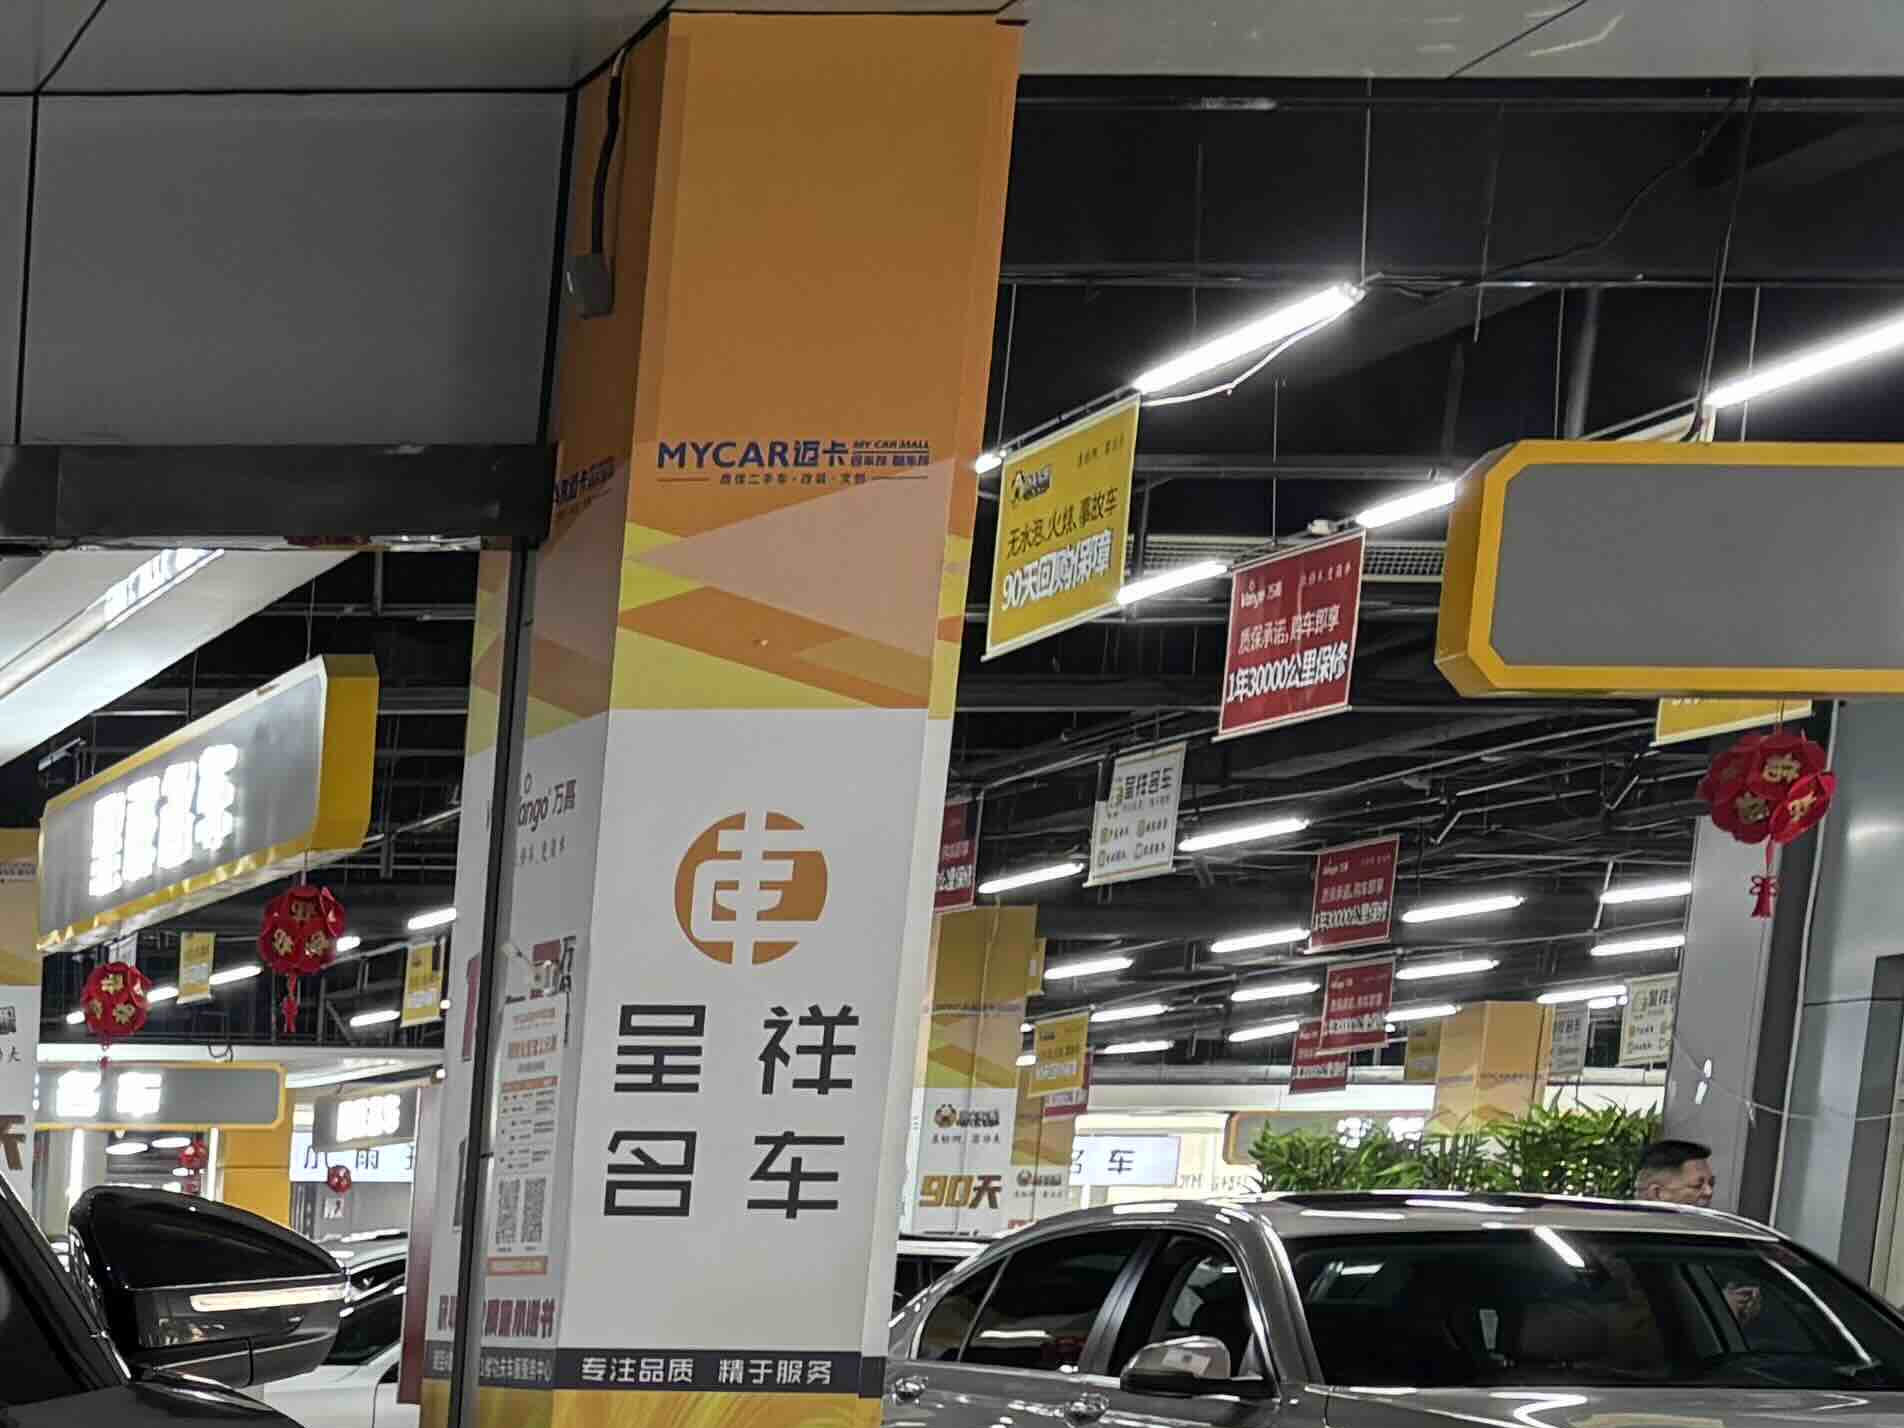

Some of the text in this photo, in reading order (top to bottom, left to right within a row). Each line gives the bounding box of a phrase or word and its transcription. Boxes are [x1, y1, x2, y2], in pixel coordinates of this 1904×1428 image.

[1227, 640, 1348, 703] 1年30000公里保修
[614, 1004, 860, 1096] 呈祥
[603, 1131, 845, 1219] 名车
[919, 1174, 1003, 1209] 90天
[581, 1357, 694, 1384] 专注品质
[718, 1358, 832, 1385] 精于服务
